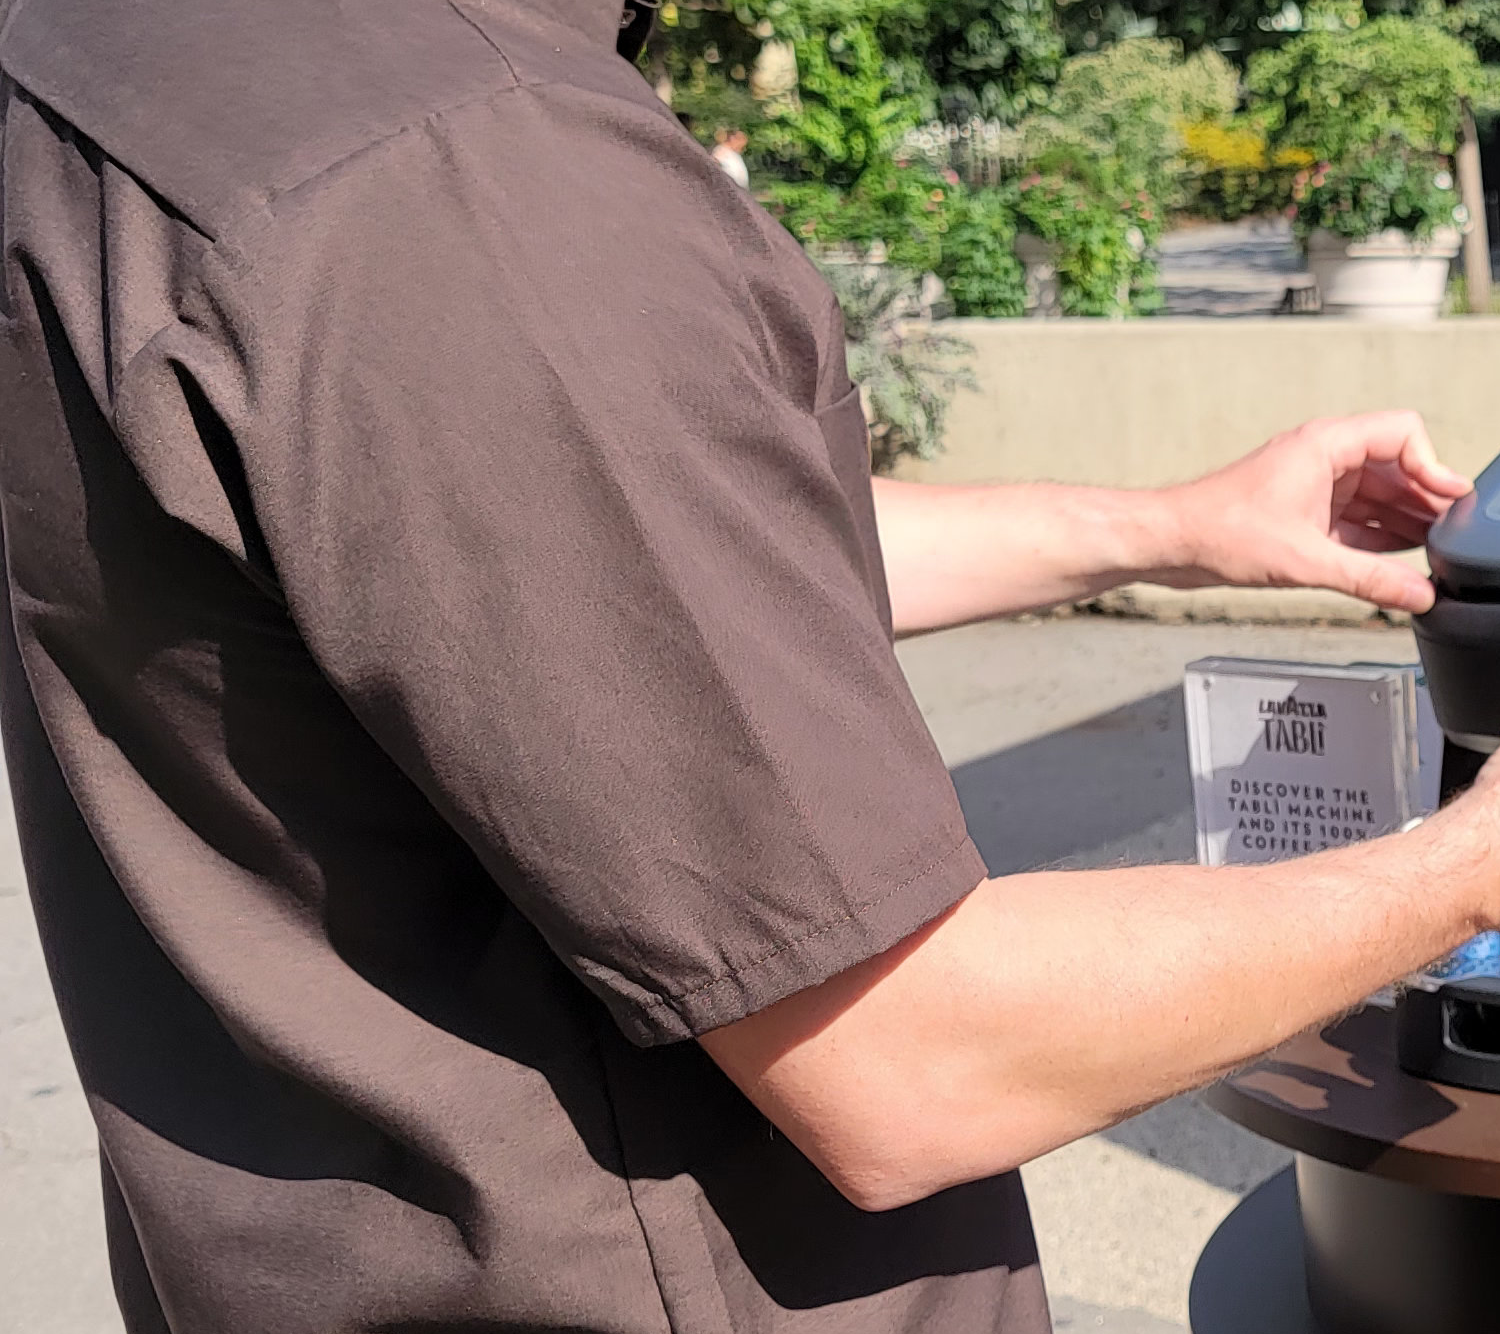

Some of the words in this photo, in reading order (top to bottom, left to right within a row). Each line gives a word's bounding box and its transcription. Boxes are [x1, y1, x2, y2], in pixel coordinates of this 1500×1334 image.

[1230, 778, 1325, 802] DISCOVER
[1332, 787, 1370, 805] THE
[1287, 803, 1376, 824] MACHINE
[1237, 817, 1276, 833] AND
[1282, 820, 1312, 836] ITS
[1242, 833, 1313, 852] COFFEE
